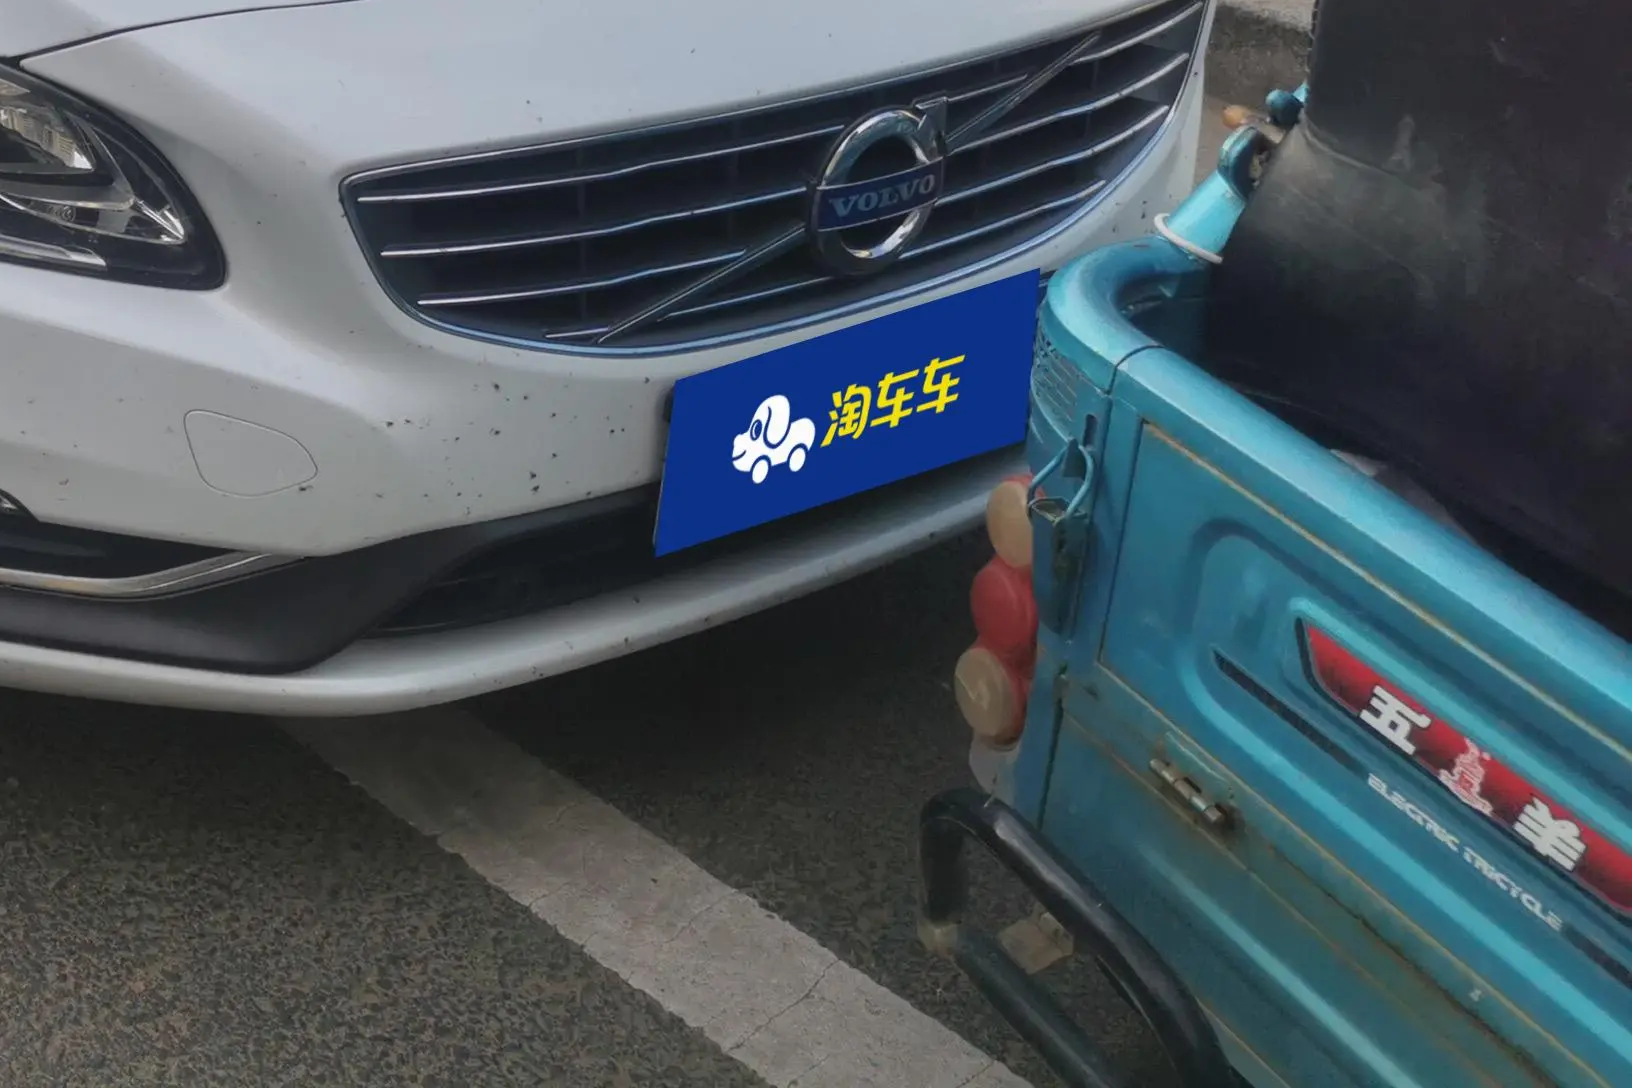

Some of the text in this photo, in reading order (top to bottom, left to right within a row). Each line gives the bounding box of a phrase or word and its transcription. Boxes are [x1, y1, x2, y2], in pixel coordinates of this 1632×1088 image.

[829, 174, 935, 217] VOLVO
[1359, 684, 1587, 872] 五 羊
[1367, 772, 1564, 933] ELECTRIC TRICYCLE
